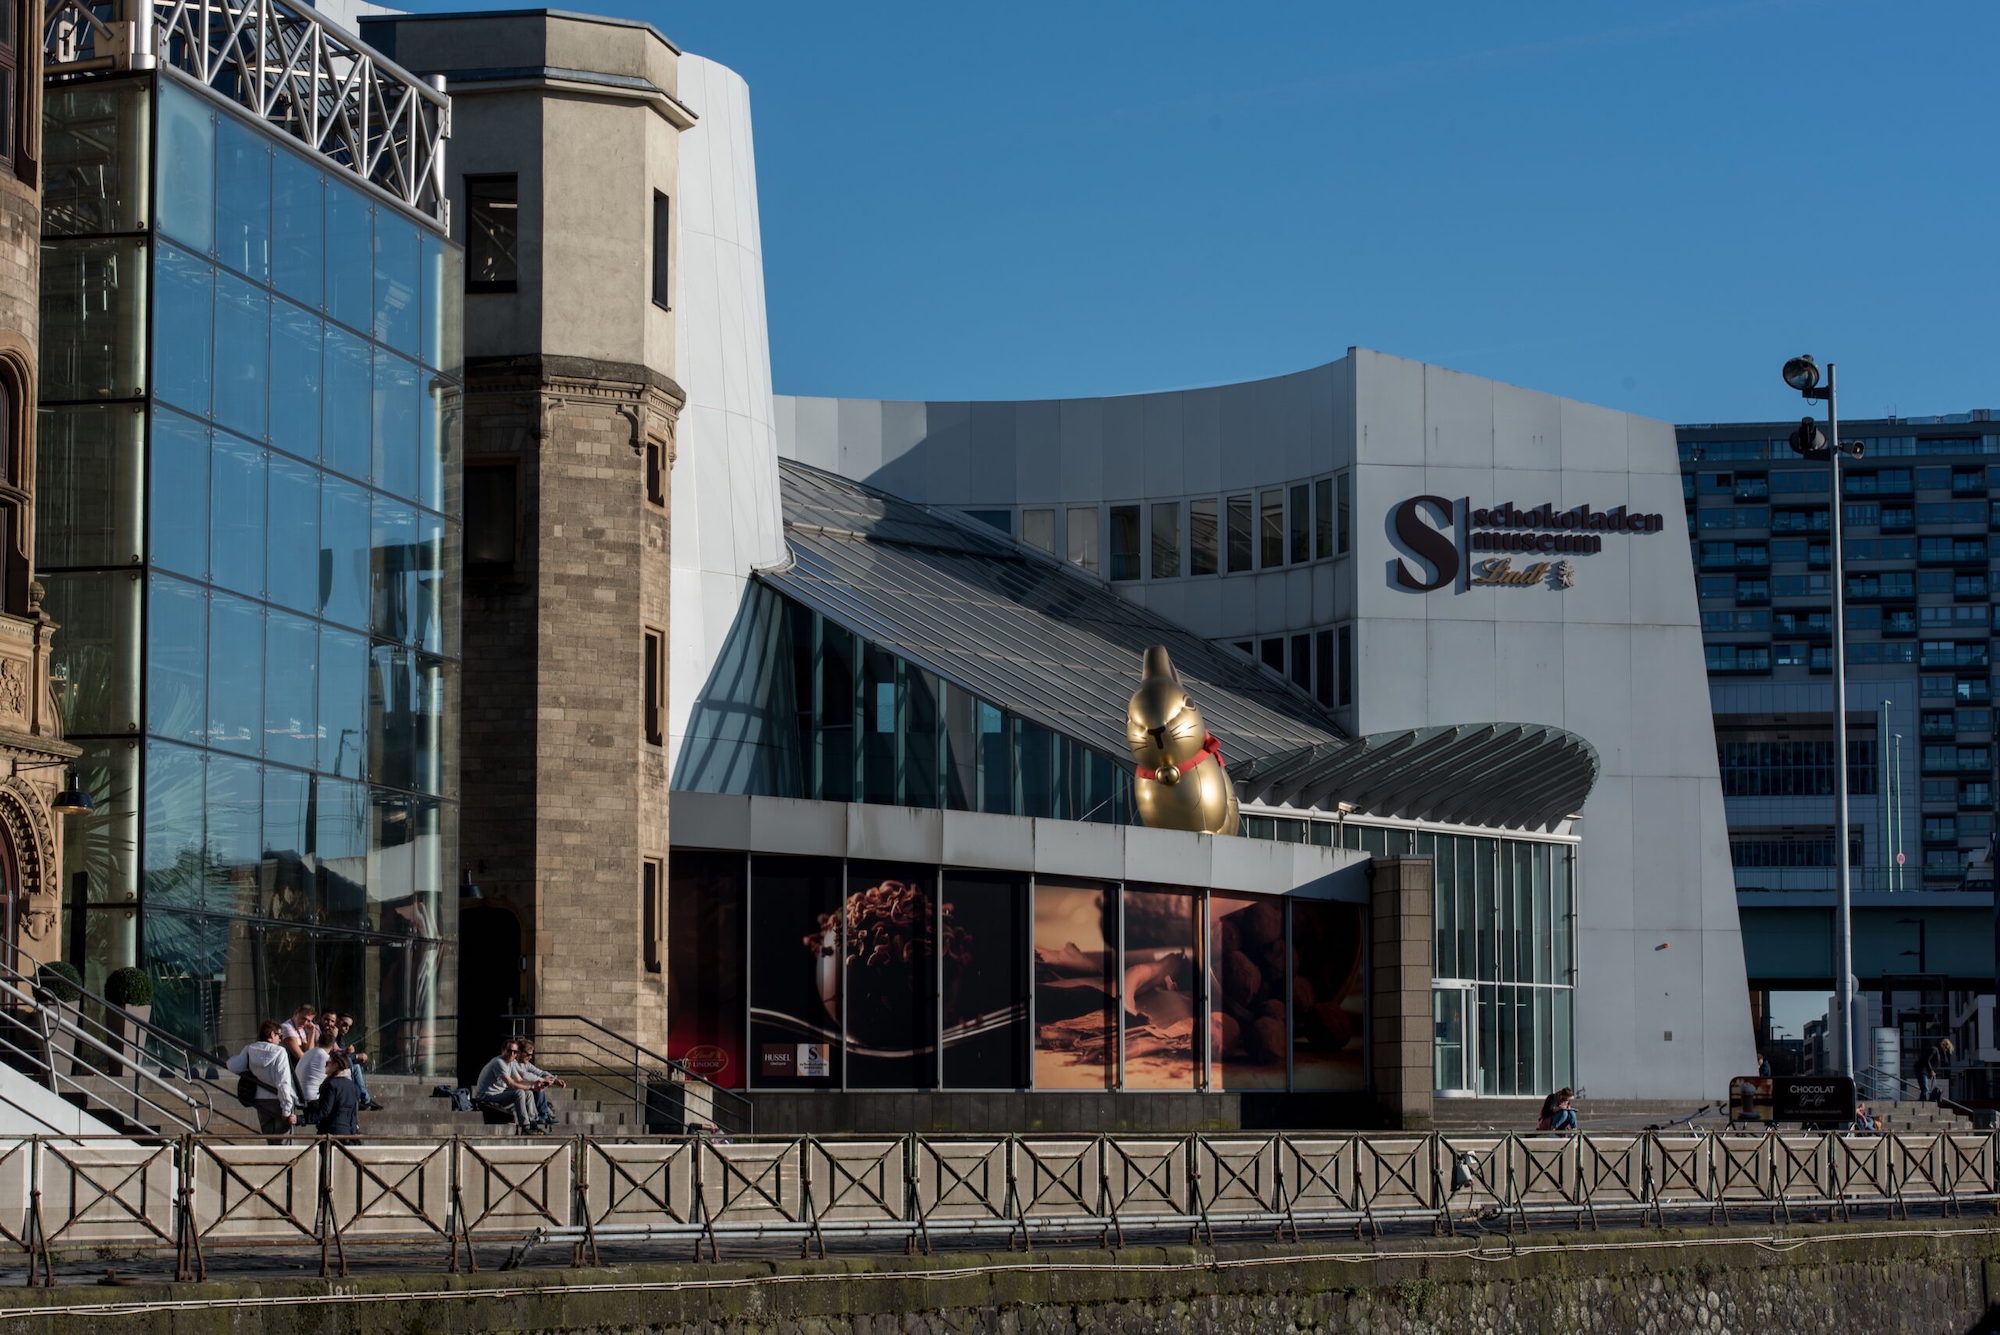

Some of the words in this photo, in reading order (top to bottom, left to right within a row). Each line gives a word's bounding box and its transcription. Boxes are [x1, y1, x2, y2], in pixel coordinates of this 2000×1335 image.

[1473, 501, 1664, 532] schokoladen
[1396, 494, 1460, 592] S
[1472, 531, 1602, 553] museum
[1475, 557, 1551, 585] Lindt
[765, 1053, 790, 1061] HUSSEL
[1790, 1085, 1835, 1094] CHOCOLAT
